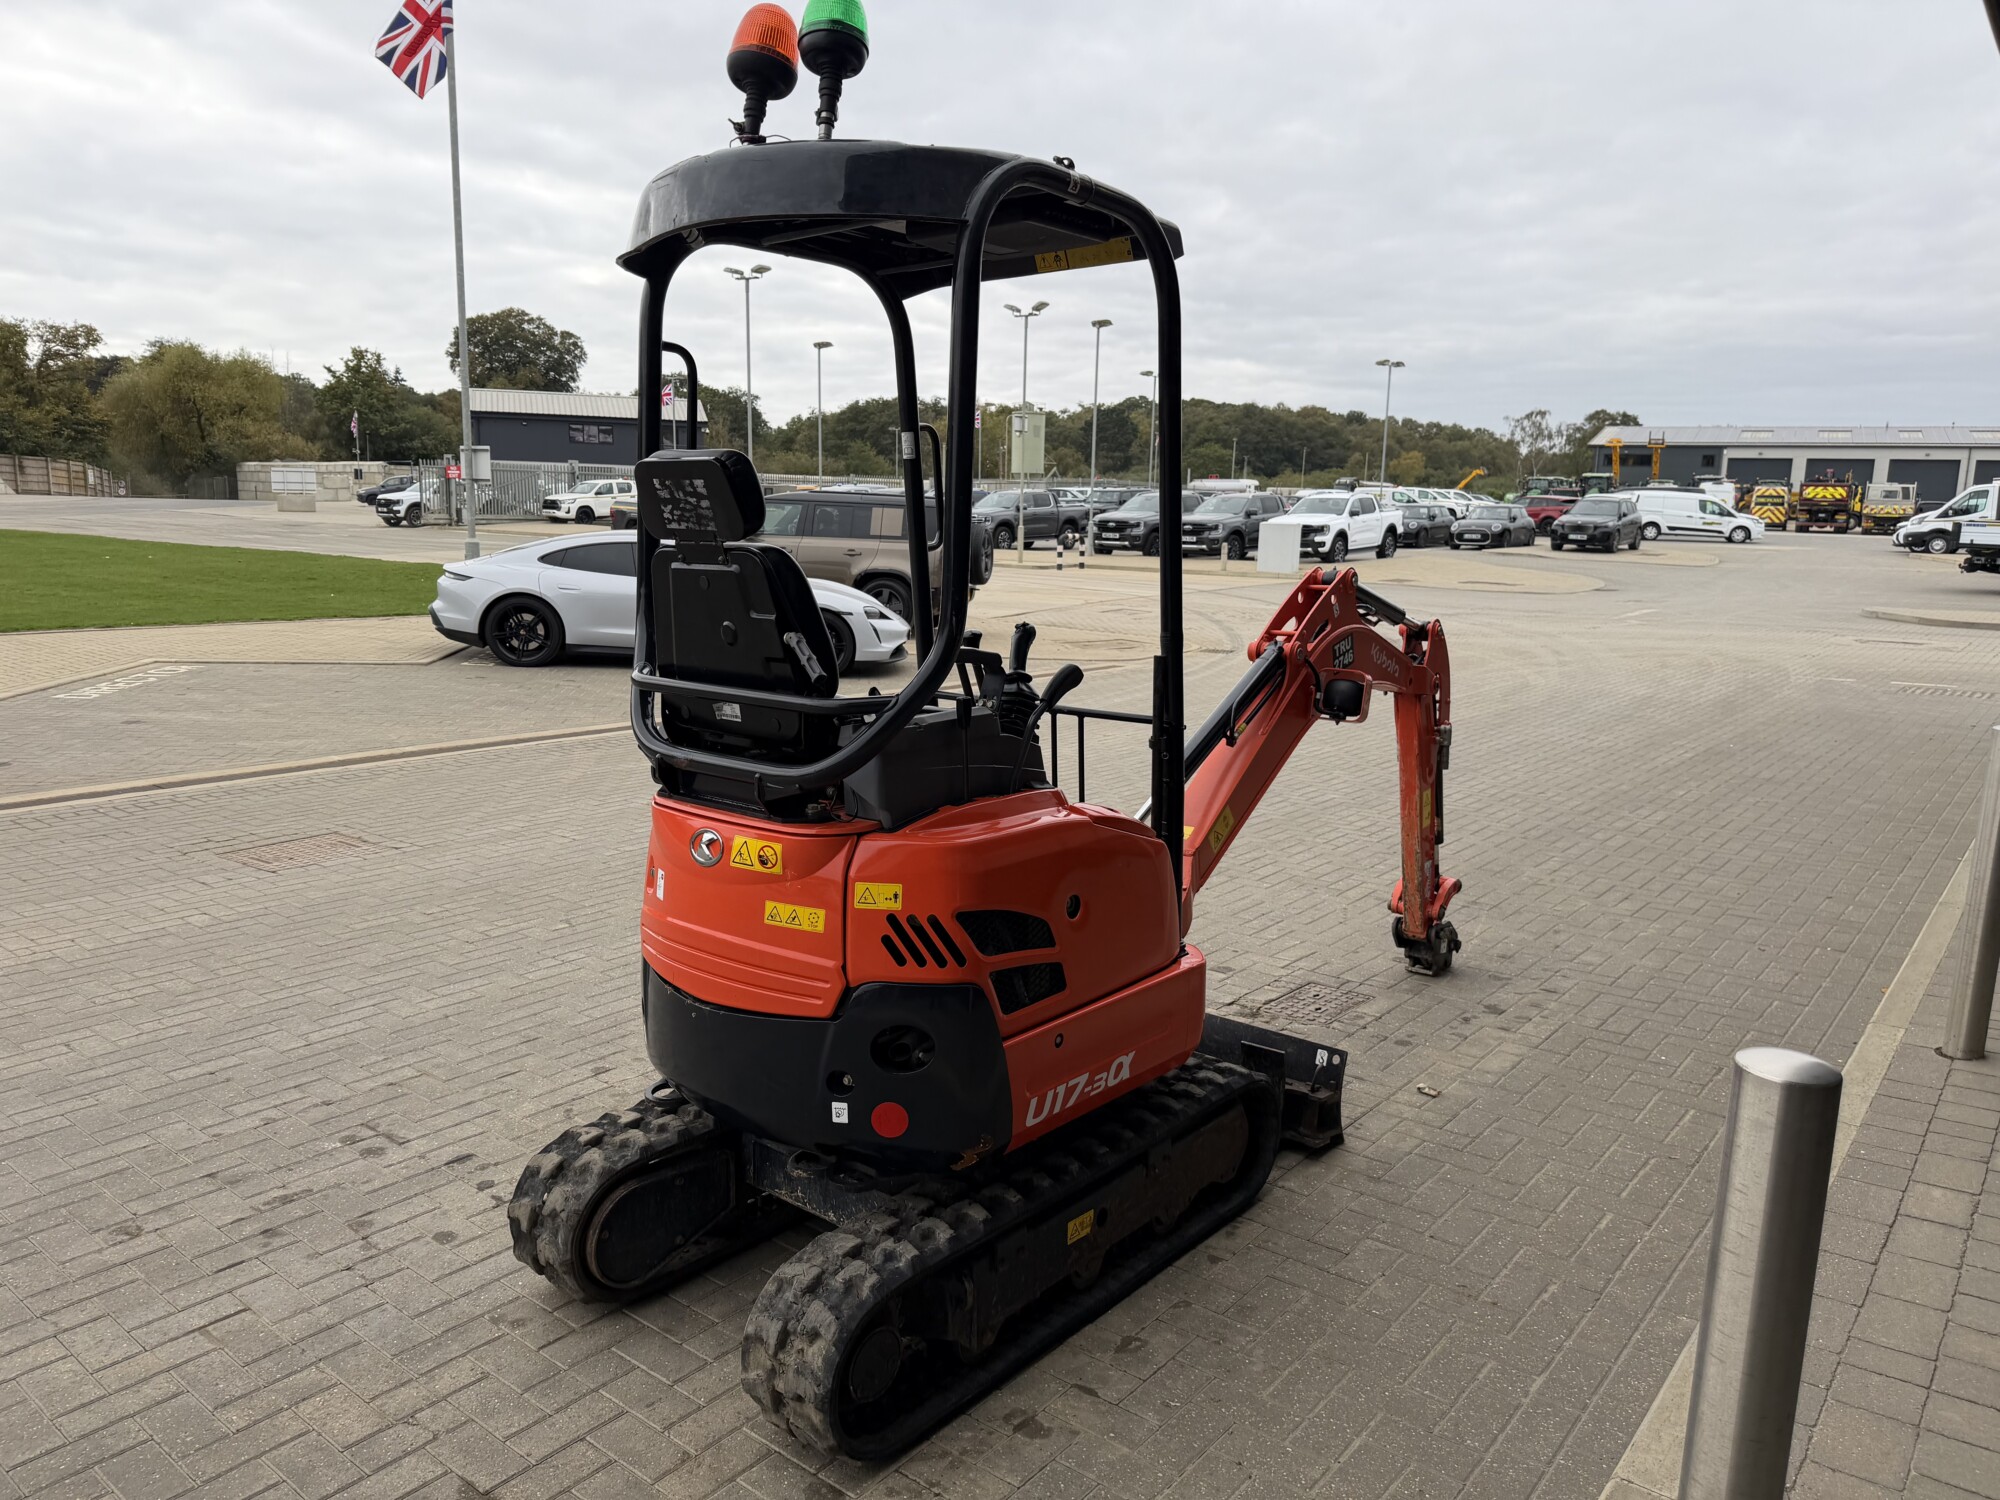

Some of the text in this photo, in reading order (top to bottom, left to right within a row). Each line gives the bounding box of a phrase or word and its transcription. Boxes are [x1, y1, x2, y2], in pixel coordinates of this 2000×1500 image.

[1334, 635, 1352, 657] TRU
[1334, 650, 1354, 669] 2746
[1371, 642, 1400, 677] Kubota
